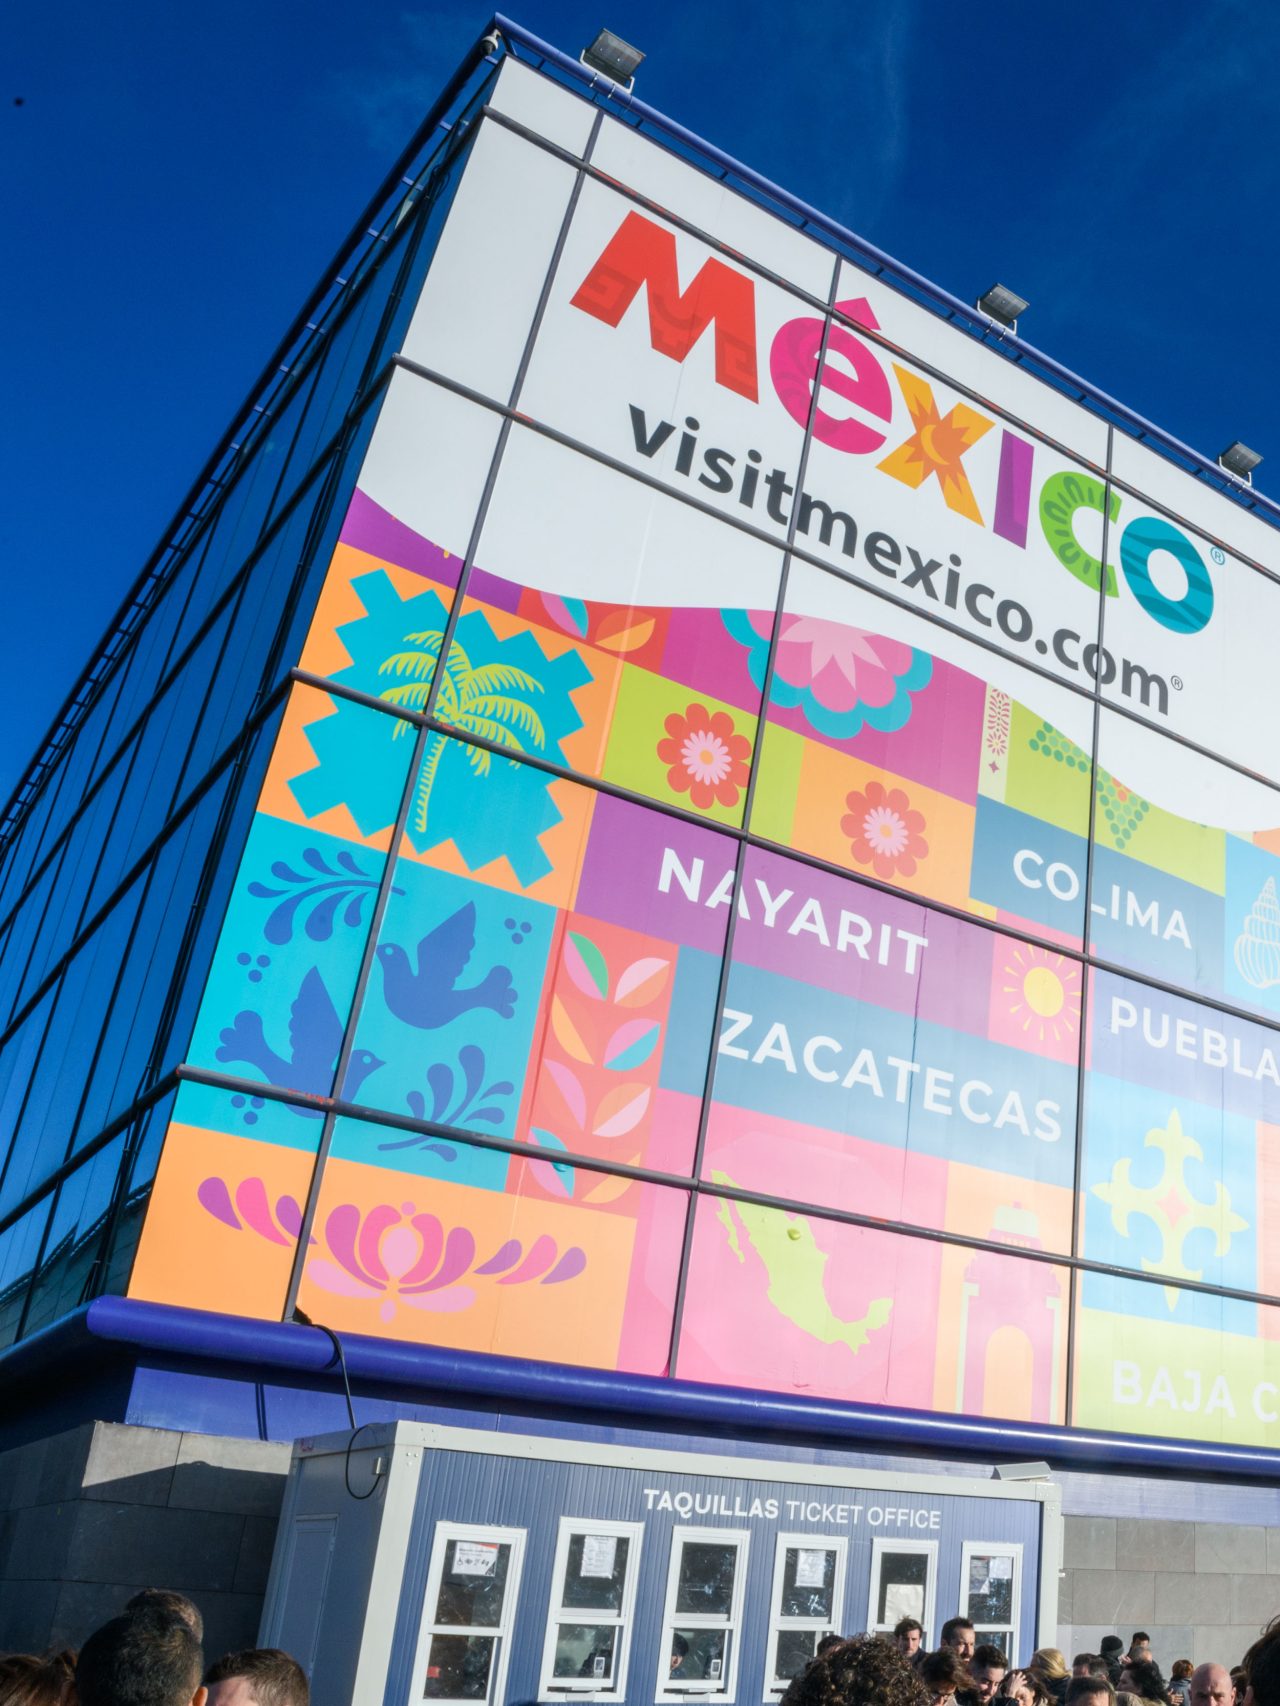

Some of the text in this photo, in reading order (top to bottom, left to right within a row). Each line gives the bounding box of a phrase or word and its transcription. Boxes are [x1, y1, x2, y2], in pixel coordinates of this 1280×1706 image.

[657, 848, 928, 976] NAYARIT
[717, 1008, 1062, 1143] ZACATECAS
[1112, 1360, 1236, 1419] BAJA
[644, 1489, 941, 1530] TAQUILLAS TICKET OFFICE
